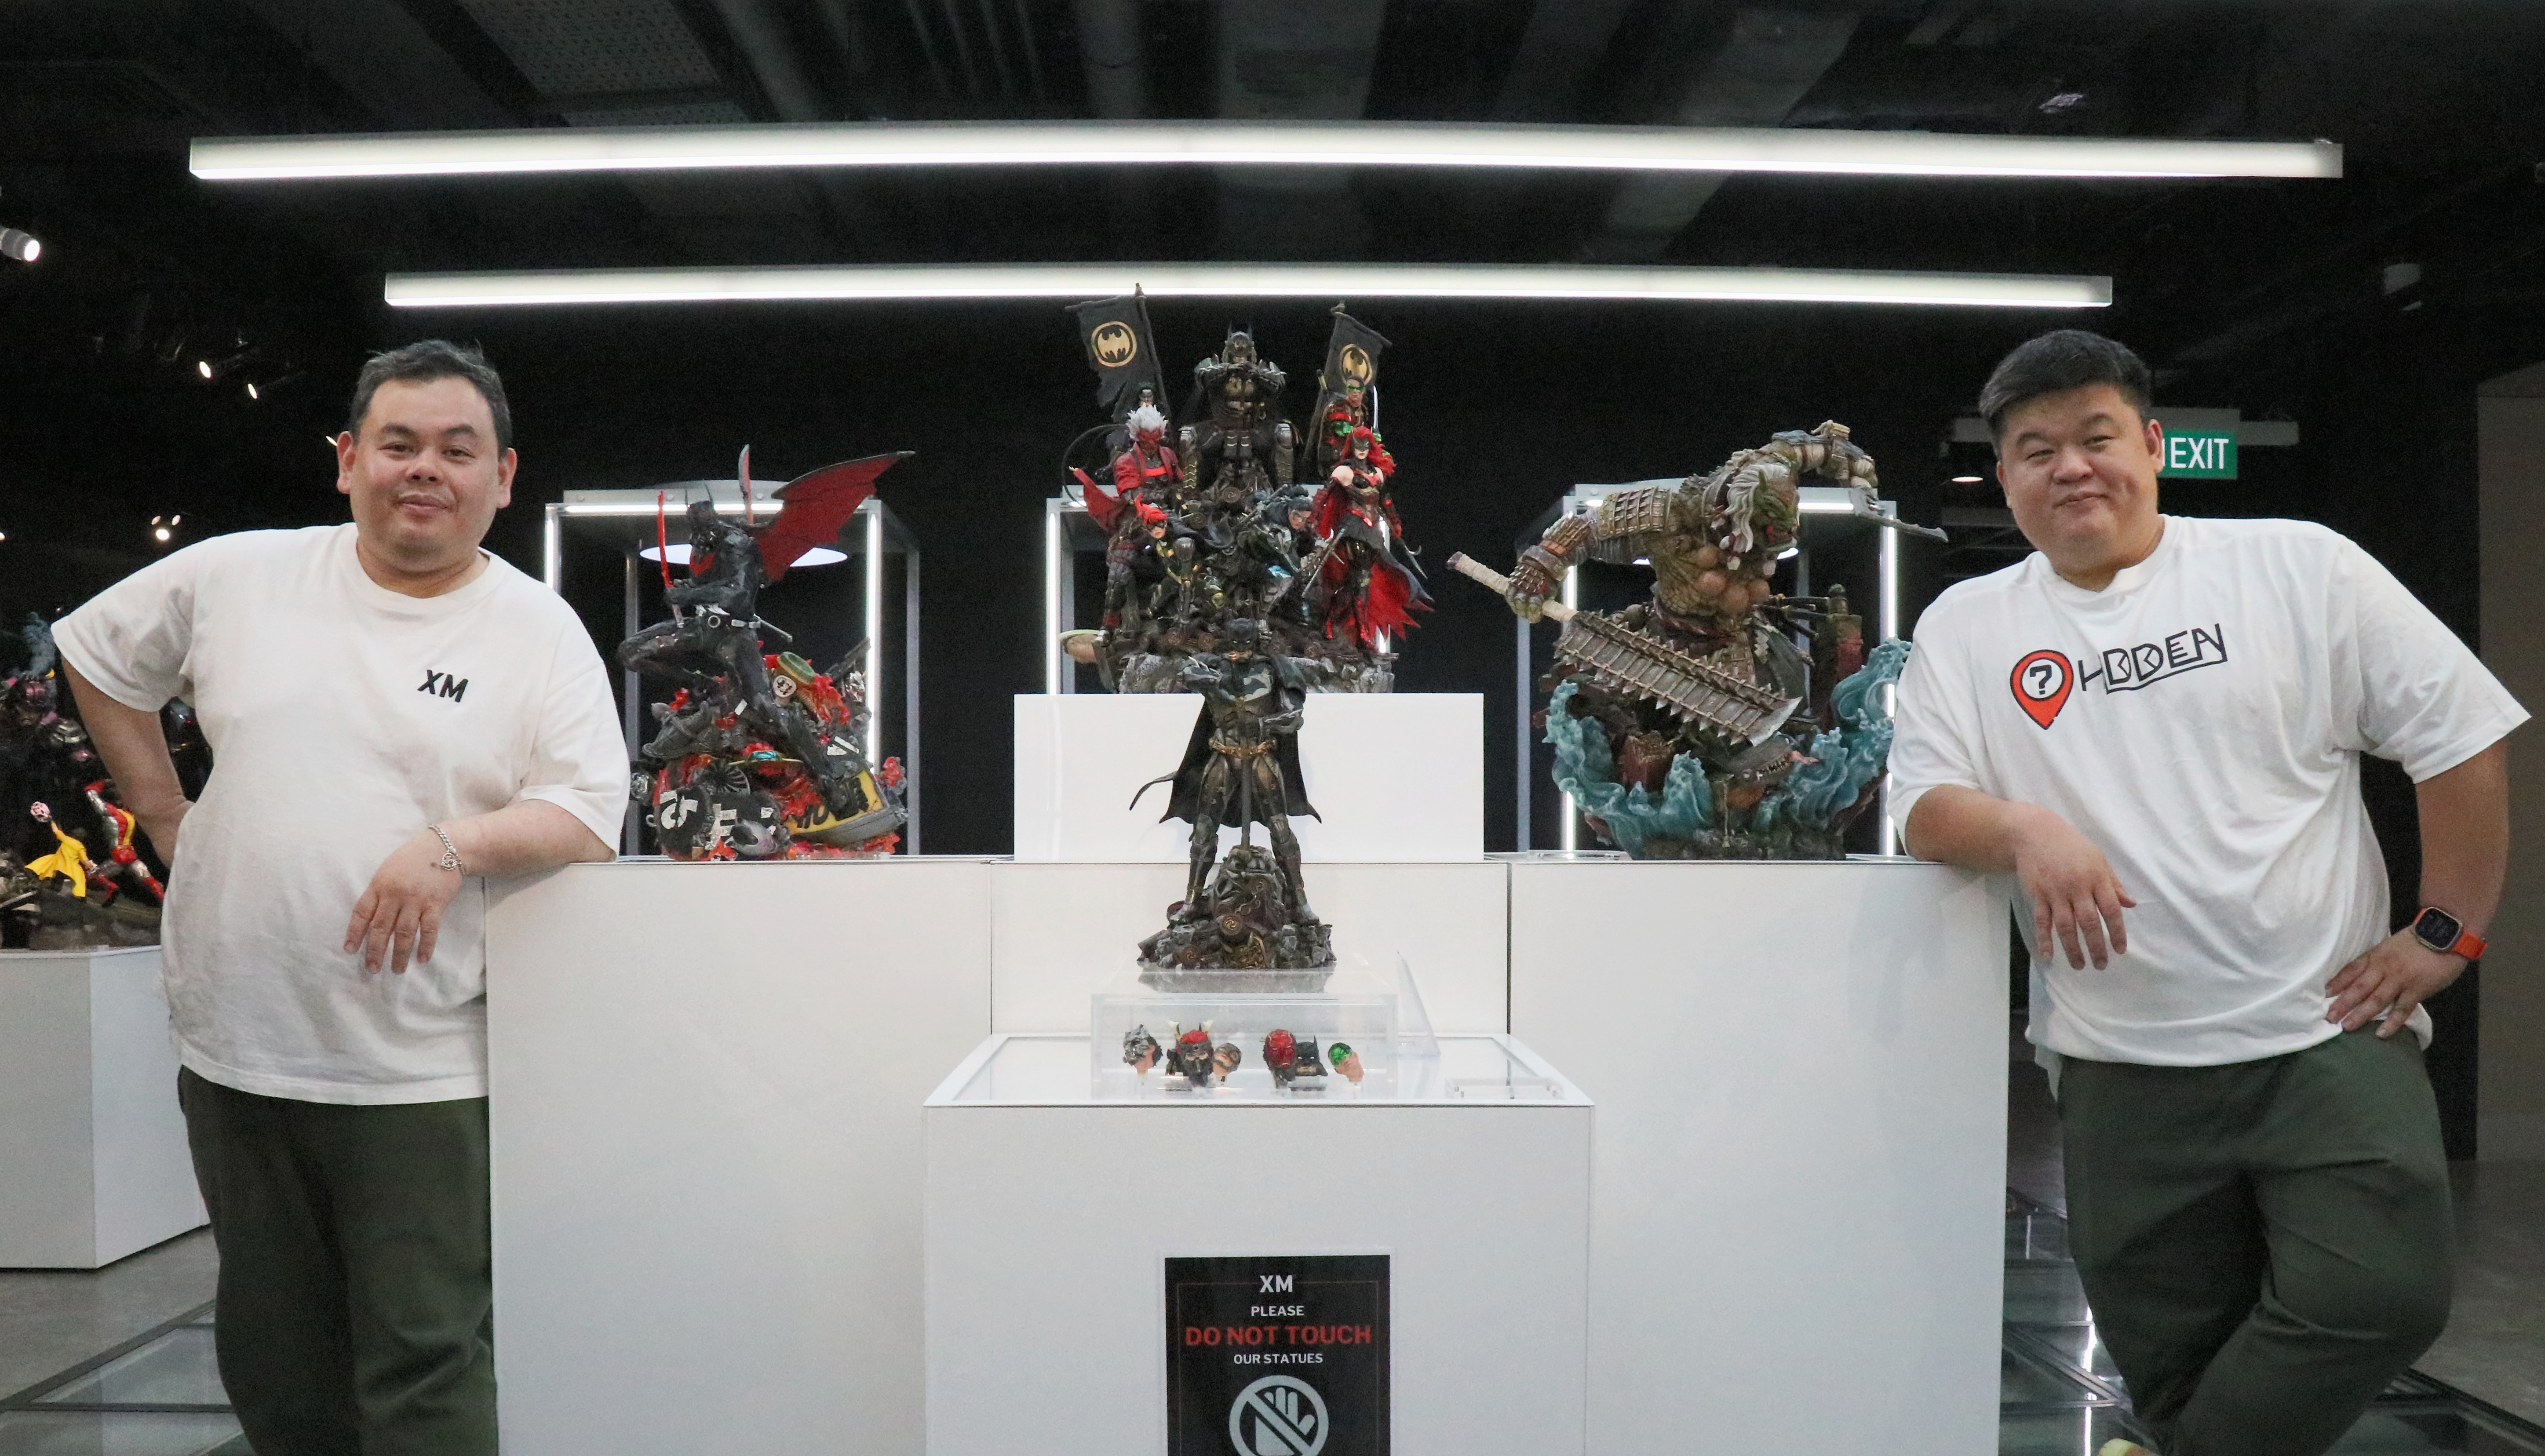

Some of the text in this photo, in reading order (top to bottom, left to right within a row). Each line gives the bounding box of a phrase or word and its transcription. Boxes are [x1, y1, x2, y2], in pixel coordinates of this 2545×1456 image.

[2170, 437, 2229, 469] EXIT
[2078, 623, 2228, 695] HDDEN
[417, 669, 468, 703] XM
[1259, 1274, 1293, 1293] XM
[1251, 1305, 1305, 1317] PLEASE
[1185, 1325, 1371, 1345] DO NOT TOUCH
[1233, 1353, 1324, 1364] OUR STATUES
